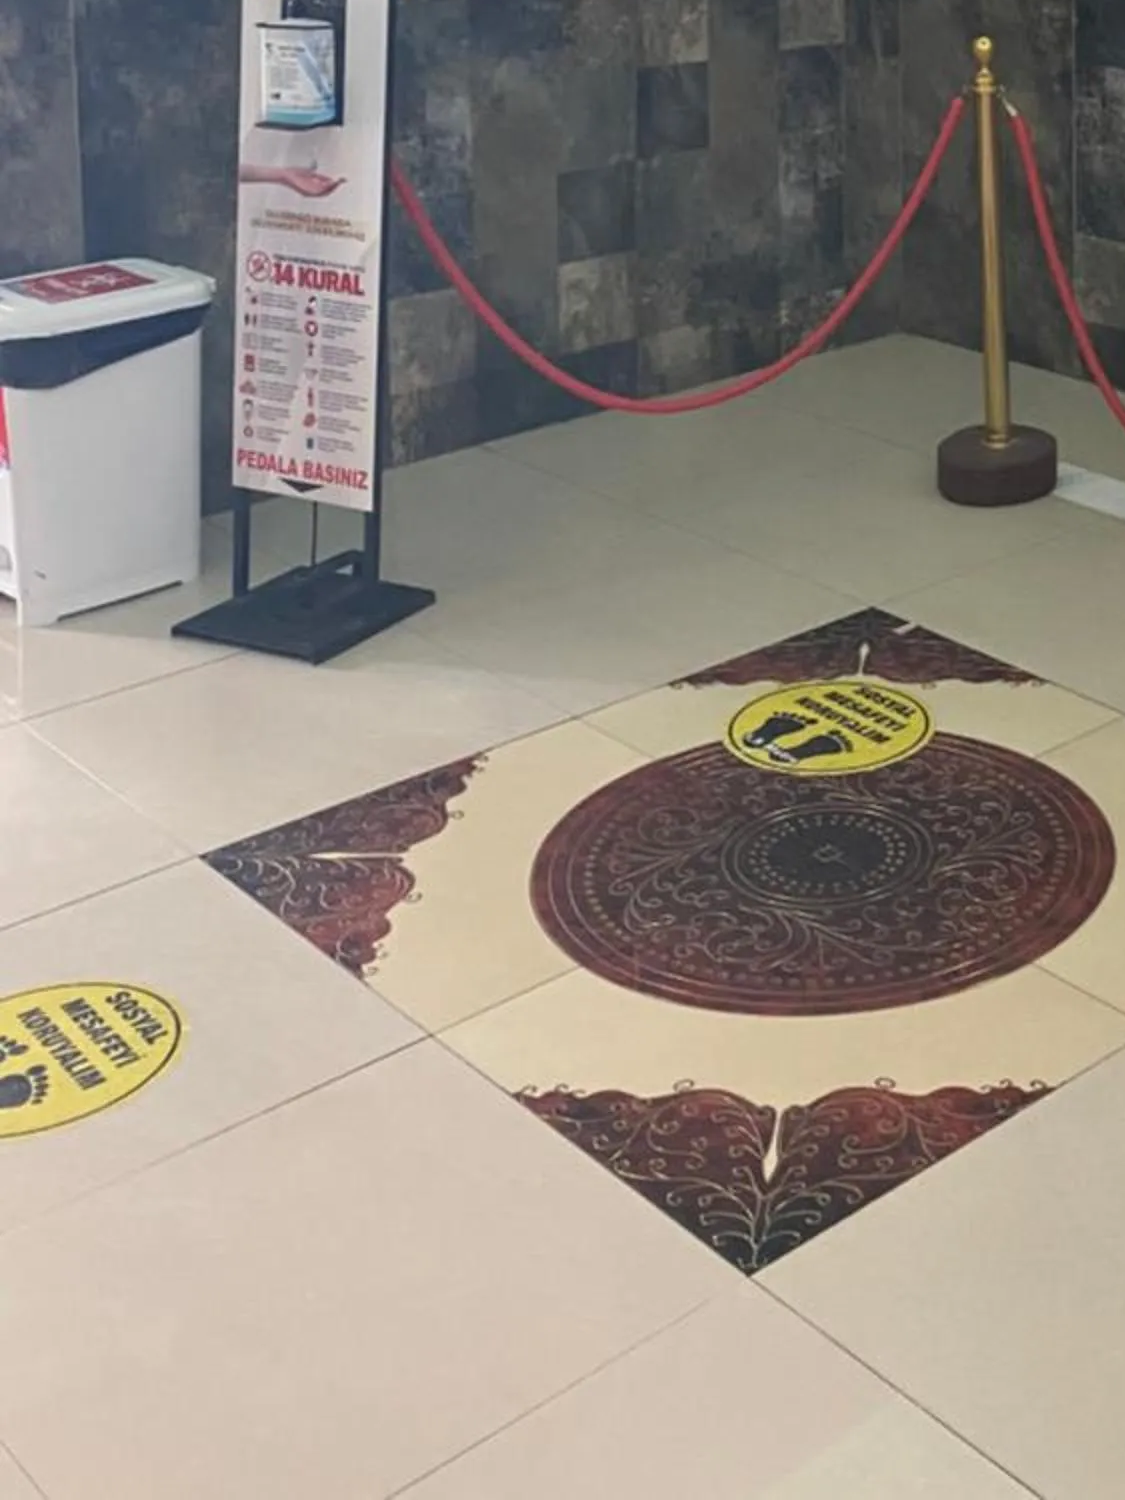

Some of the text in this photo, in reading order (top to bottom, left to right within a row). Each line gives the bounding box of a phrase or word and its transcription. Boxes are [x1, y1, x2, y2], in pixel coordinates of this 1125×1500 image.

[273, 261, 295, 286] 14
[298, 264, 366, 297] KURAL
[236, 447, 369, 490] PEDALA BASINIZ
[105, 990, 168, 1046] SOSYAL
[17, 1006, 108, 1091] KORUYALIM
